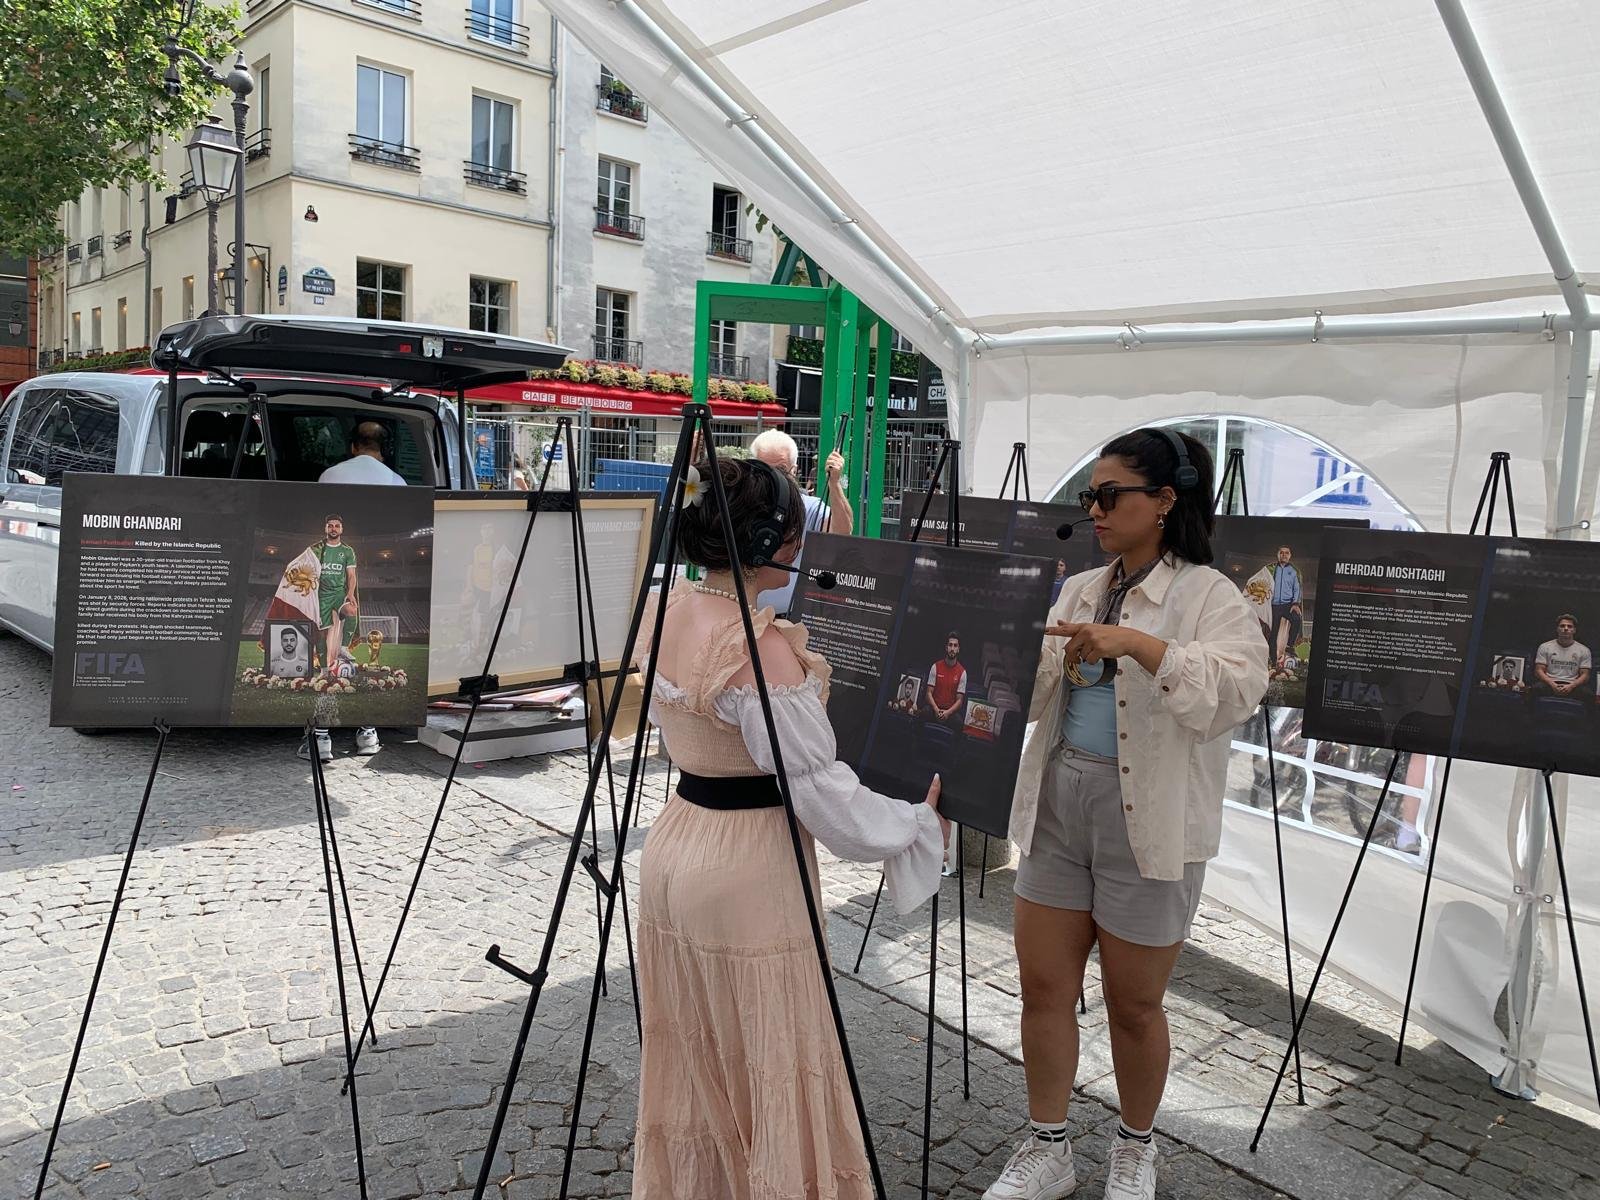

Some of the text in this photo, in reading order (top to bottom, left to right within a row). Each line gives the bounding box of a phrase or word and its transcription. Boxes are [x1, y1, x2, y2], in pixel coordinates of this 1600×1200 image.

[522, 392, 632, 410] CAFE BEAUBOURG
[83, 514, 181, 530] MOBIN GHANBARI
[1336, 562, 1445, 582] MEHRDAD MOSHTAGHI
[78, 653, 145, 674] FIFA
[1326, 679, 1384, 704] FIFA
